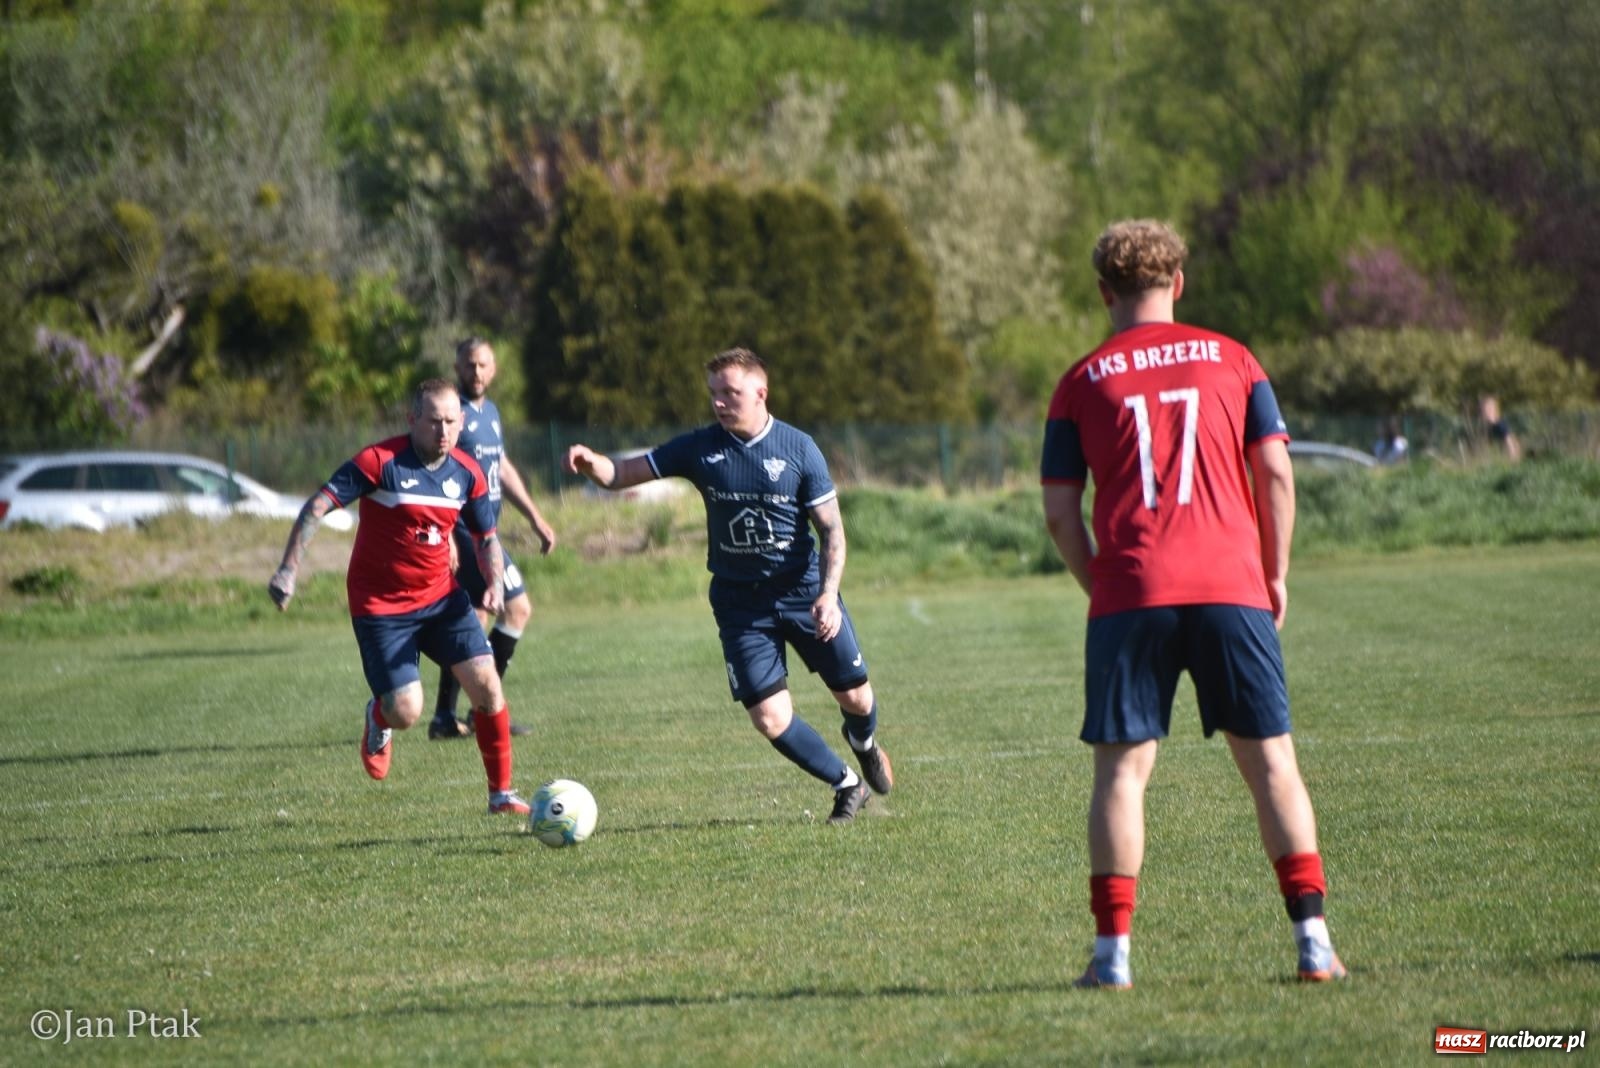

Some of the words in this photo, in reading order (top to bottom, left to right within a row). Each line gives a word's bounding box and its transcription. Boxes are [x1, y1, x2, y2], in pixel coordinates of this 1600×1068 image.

[1087, 352, 1128, 382] LKS
[1132, 339, 1221, 371] BRZEZIE
[1123, 387, 1199, 509] 17
